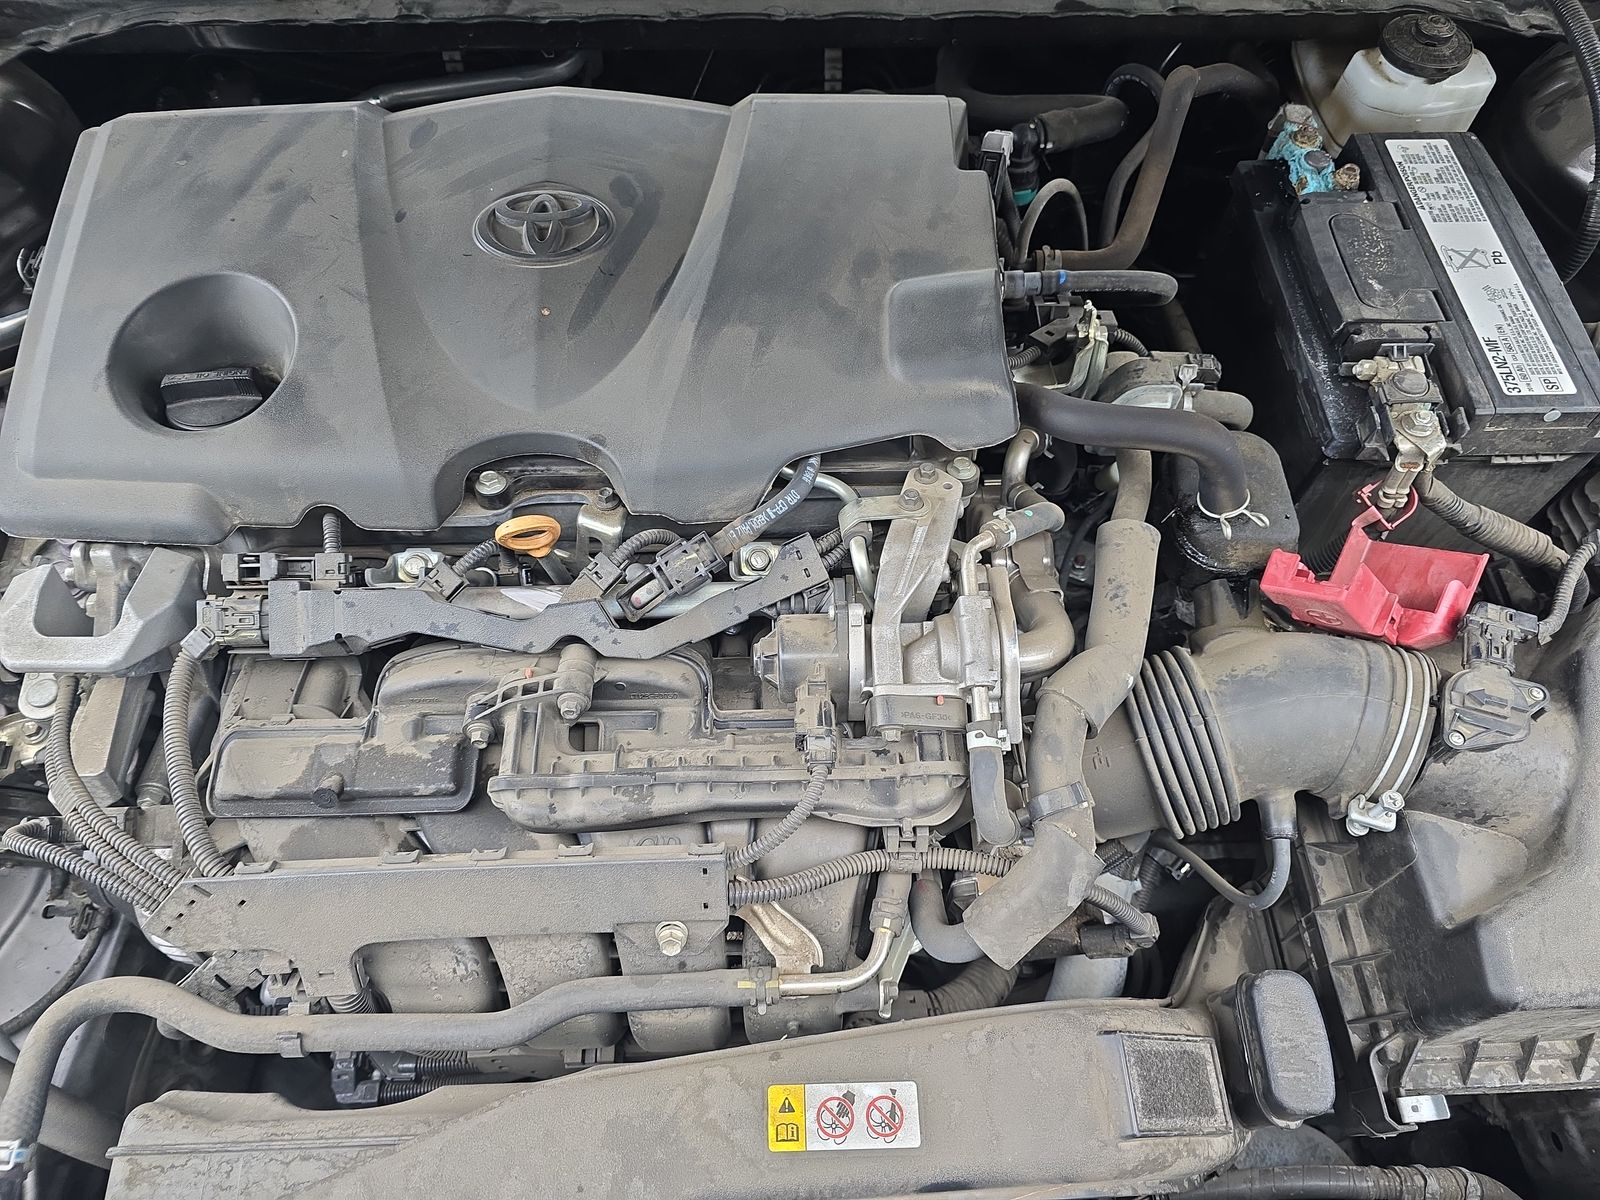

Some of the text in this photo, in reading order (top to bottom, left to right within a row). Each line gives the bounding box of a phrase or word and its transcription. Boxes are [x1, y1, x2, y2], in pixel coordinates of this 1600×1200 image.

[1491, 250, 1507, 265] Pb
[1482, 336, 1522, 393] 375LN2-MF
[1542, 378, 1560, 390] SP
